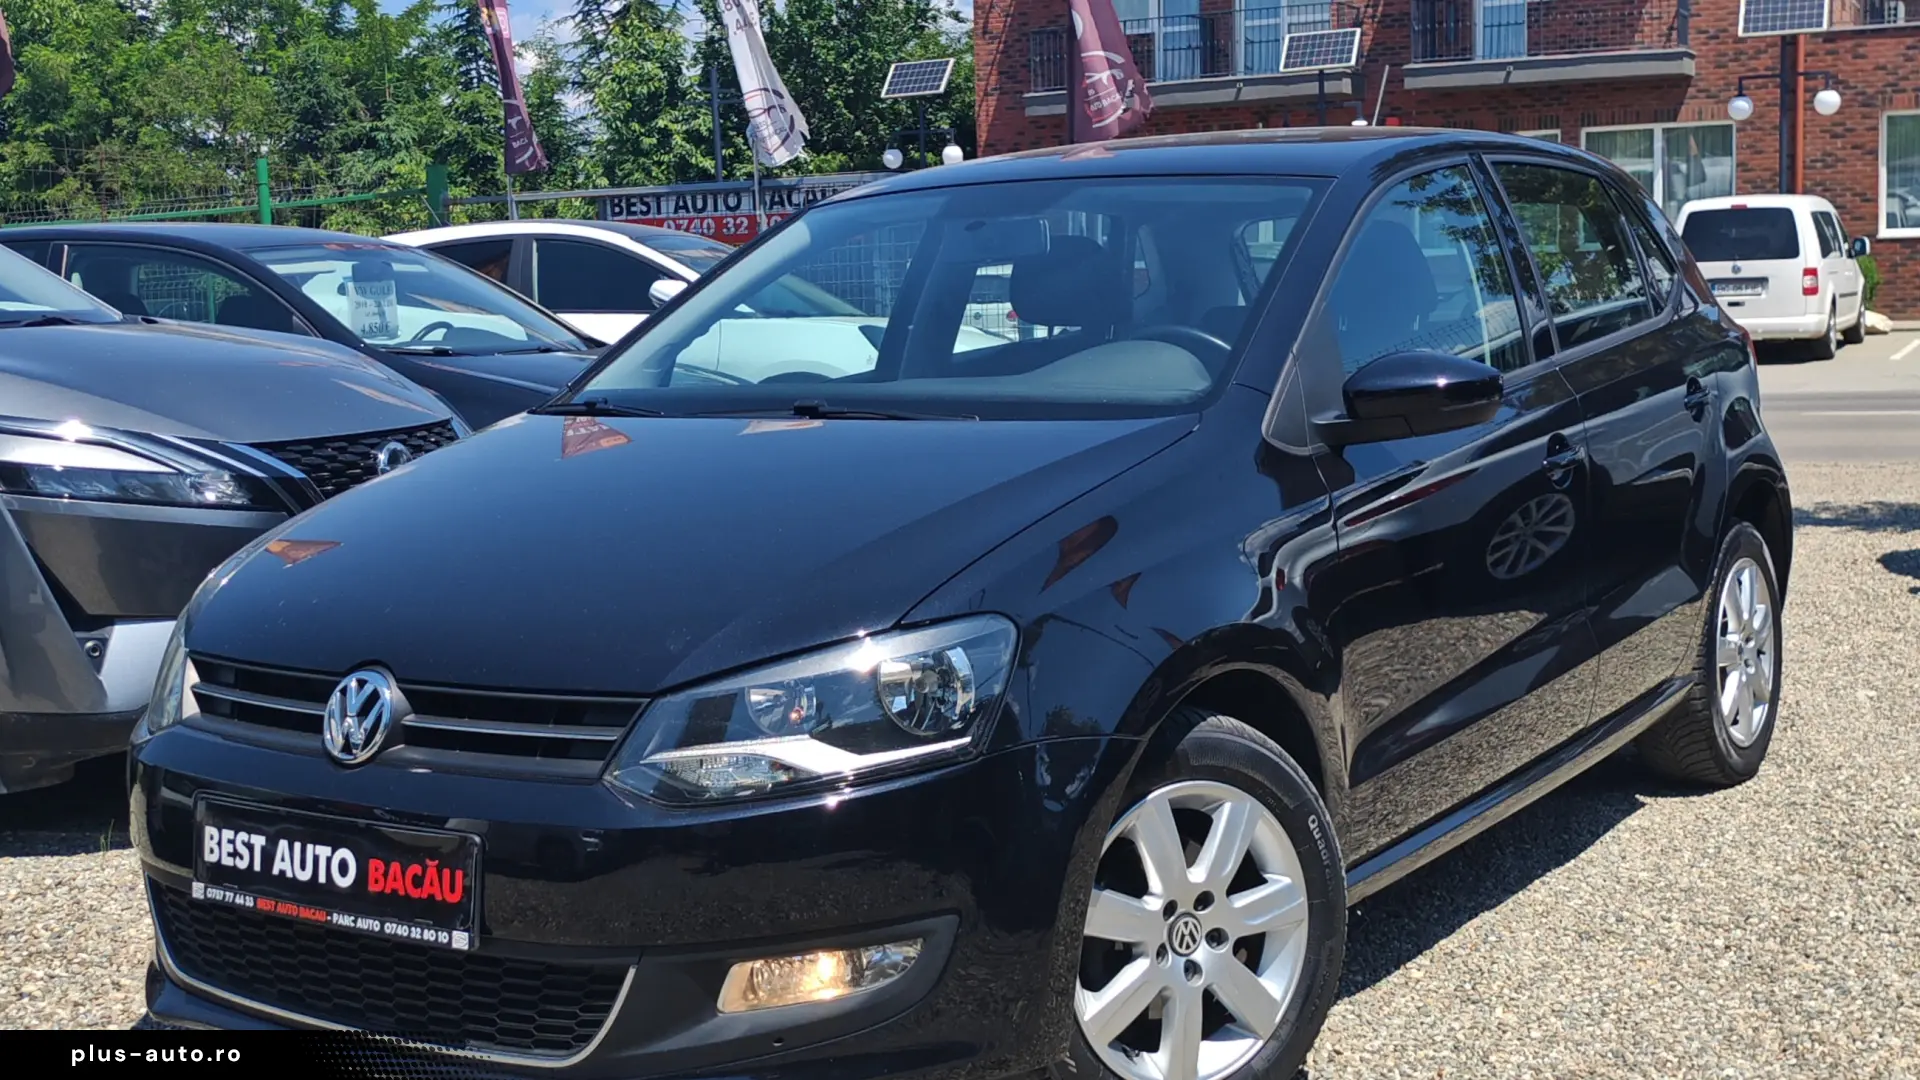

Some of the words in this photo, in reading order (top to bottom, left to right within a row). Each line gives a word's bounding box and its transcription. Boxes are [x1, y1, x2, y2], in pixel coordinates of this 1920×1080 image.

[610, 195, 663, 217] BEST
[673, 192, 743, 214] AUTO
[722, 216, 749, 235] 32
[204, 825, 266, 872] BEST
[272, 838, 357, 889] AUTO
[368, 857, 464, 904] BACĂU
[256, 897, 276, 912] BEST
[276, 902, 298, 917] AUTO
[332, 913, 355, 927] PARC
[356, 917, 380, 932] AUTO
[384, 922, 409, 937] 0740
[410, 926, 422, 940] 32
[423, 928, 436, 942] 80
[437, 931, 449, 944] 10
